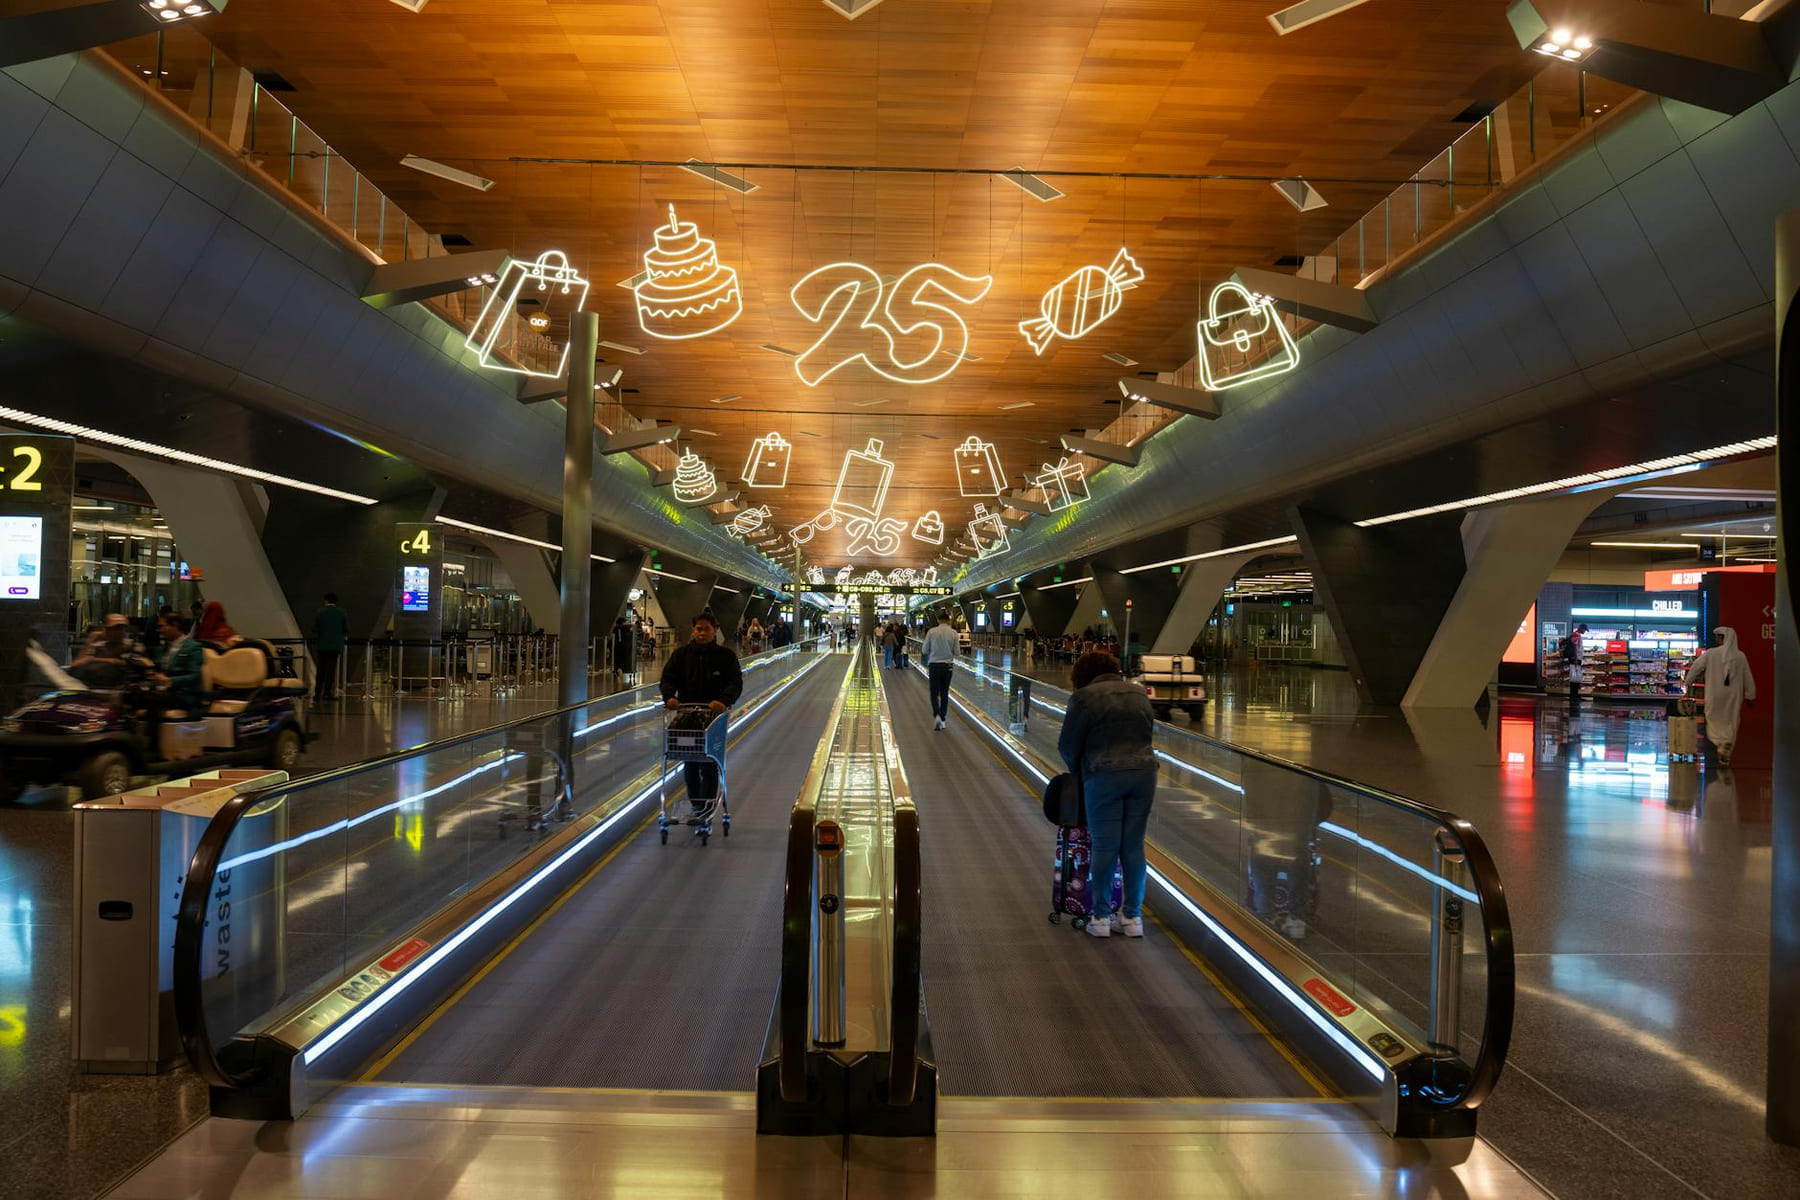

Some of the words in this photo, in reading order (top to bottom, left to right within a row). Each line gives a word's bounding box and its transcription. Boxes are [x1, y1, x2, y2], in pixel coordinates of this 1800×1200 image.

[530, 318, 548, 327] QDF
[791, 262, 993, 386] 25
[0, 446, 42, 491] 2
[845, 517, 908, 557] 25
[1652, 600, 1682, 611] CHILLED
[1762, 624, 1776, 639] GE
[215, 868, 231, 978] waste
